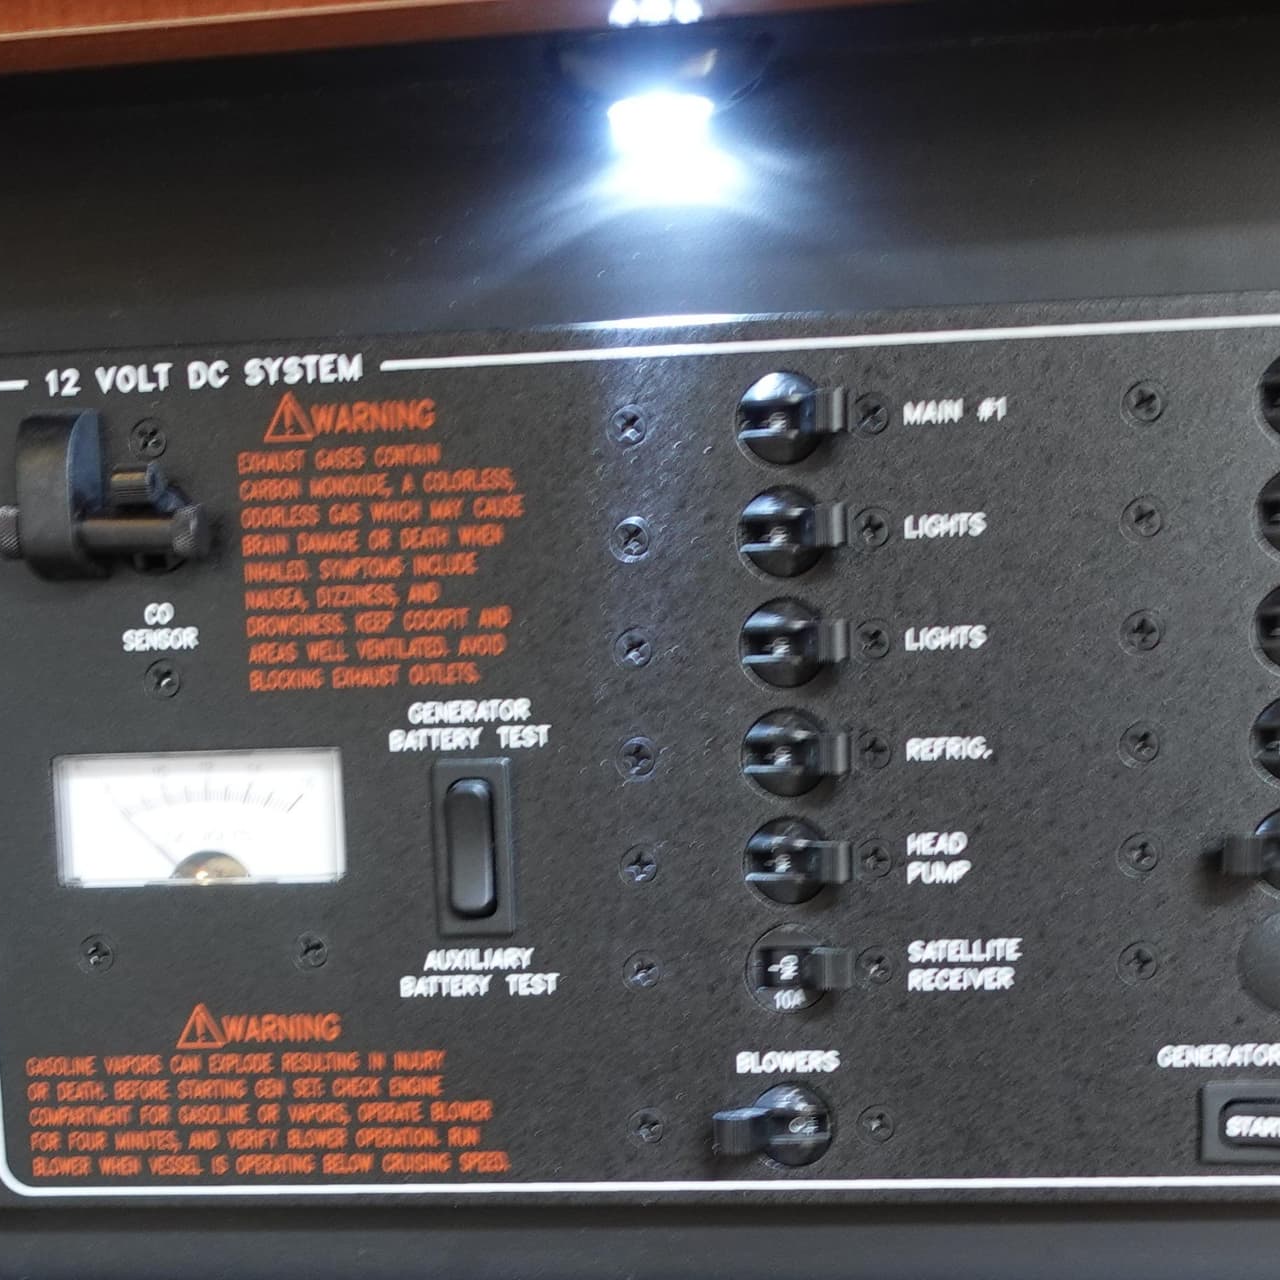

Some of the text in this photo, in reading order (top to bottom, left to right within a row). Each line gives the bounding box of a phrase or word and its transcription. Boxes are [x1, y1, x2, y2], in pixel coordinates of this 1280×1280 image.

[45, 353, 363, 396] 12 VOLT DC SYSTEM
[312, 398, 437, 434] WARNING
[903, 396, 1007, 425] MAIN #1
[238, 444, 441, 474] EXHAUST GASES CONTAIN
[401, 475, 414, 493] A
[241, 495, 523, 528] ODORLESS GAS WHICH MAY CAUSE
[904, 512, 987, 539] LIGHTS
[241, 533, 289, 556] BRAIN
[296, 529, 359, 554] DAMAGE
[367, 528, 391, 550] OR
[458, 523, 504, 546] WHEN
[412, 551, 476, 576] INCLUDE
[407, 581, 439, 603] AND
[144, 602, 174, 625] CO
[354, 610, 394, 633] KEEP
[403, 607, 469, 631] COCKPIT
[478, 606, 511, 628] AND
[122, 626, 199, 651] SENSOR
[248, 641, 297, 664] AREAS
[307, 639, 347, 662] WELL
[458, 633, 505, 656] AVOID
[905, 625, 987, 651] LIGHTS
[249, 668, 323, 691] BLOCKING
[332, 664, 400, 688] EXHAUST
[408, 698, 531, 724] GENERATOR
[389, 724, 552, 752] BATTERY TEST
[906, 736, 993, 761] REFRIG.
[907, 831, 968, 856] HEAD
[907, 860, 971, 884] PUMP
[423, 947, 534, 971] AUXILIARY
[908, 938, 1023, 963] SATELLITE
[400, 973, 561, 998] BATTERY TEST
[908, 966, 1015, 991] RECEIVER
[770, 988, 806, 1011] 10A
[221, 1012, 342, 1044] WARNING
[736, 1050, 840, 1073] BLOWERS
